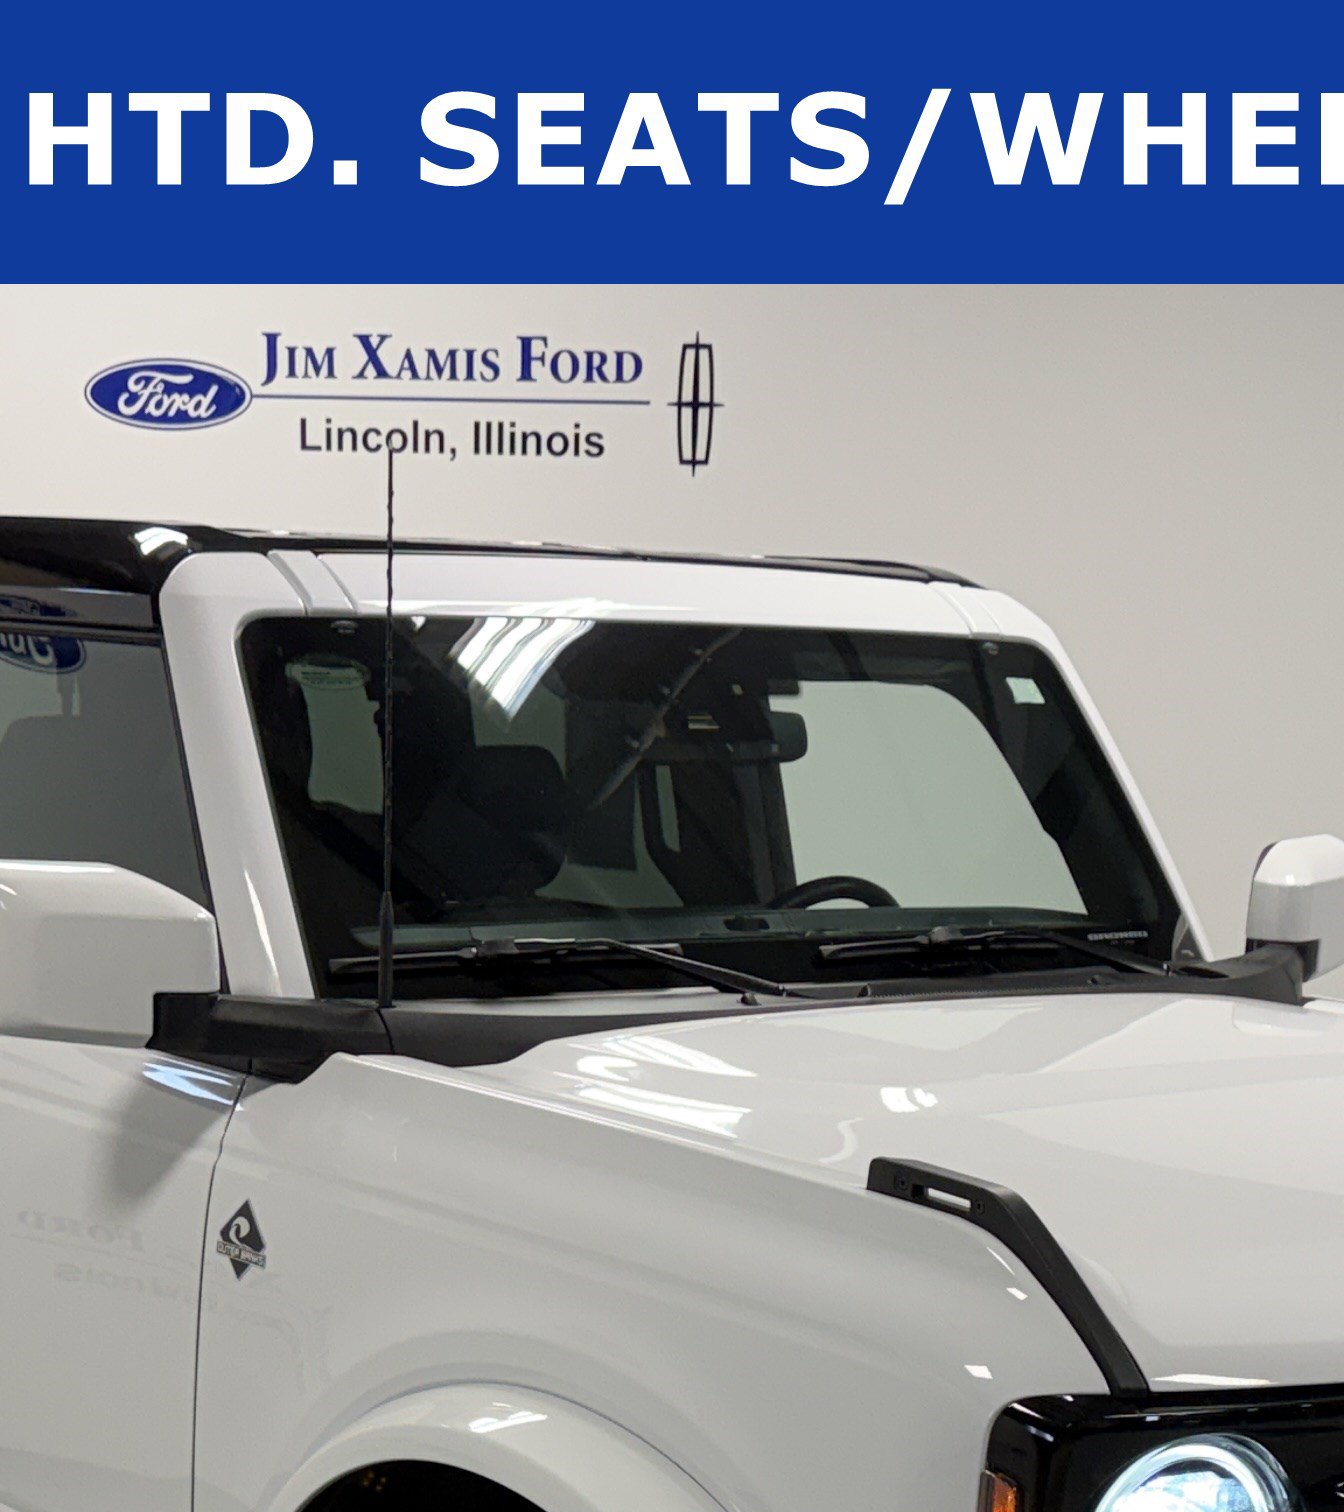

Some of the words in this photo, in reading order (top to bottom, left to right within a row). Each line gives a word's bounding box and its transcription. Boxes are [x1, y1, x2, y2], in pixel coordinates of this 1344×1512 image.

[261, 332, 337, 386] JIM
[352, 333, 500, 382] XAMIS
[516, 335, 644, 384] FORD
[117, 372, 218, 420] Ford
[299, 417, 457, 461] Lincoln,
[473, 420, 606, 458] Illinois
